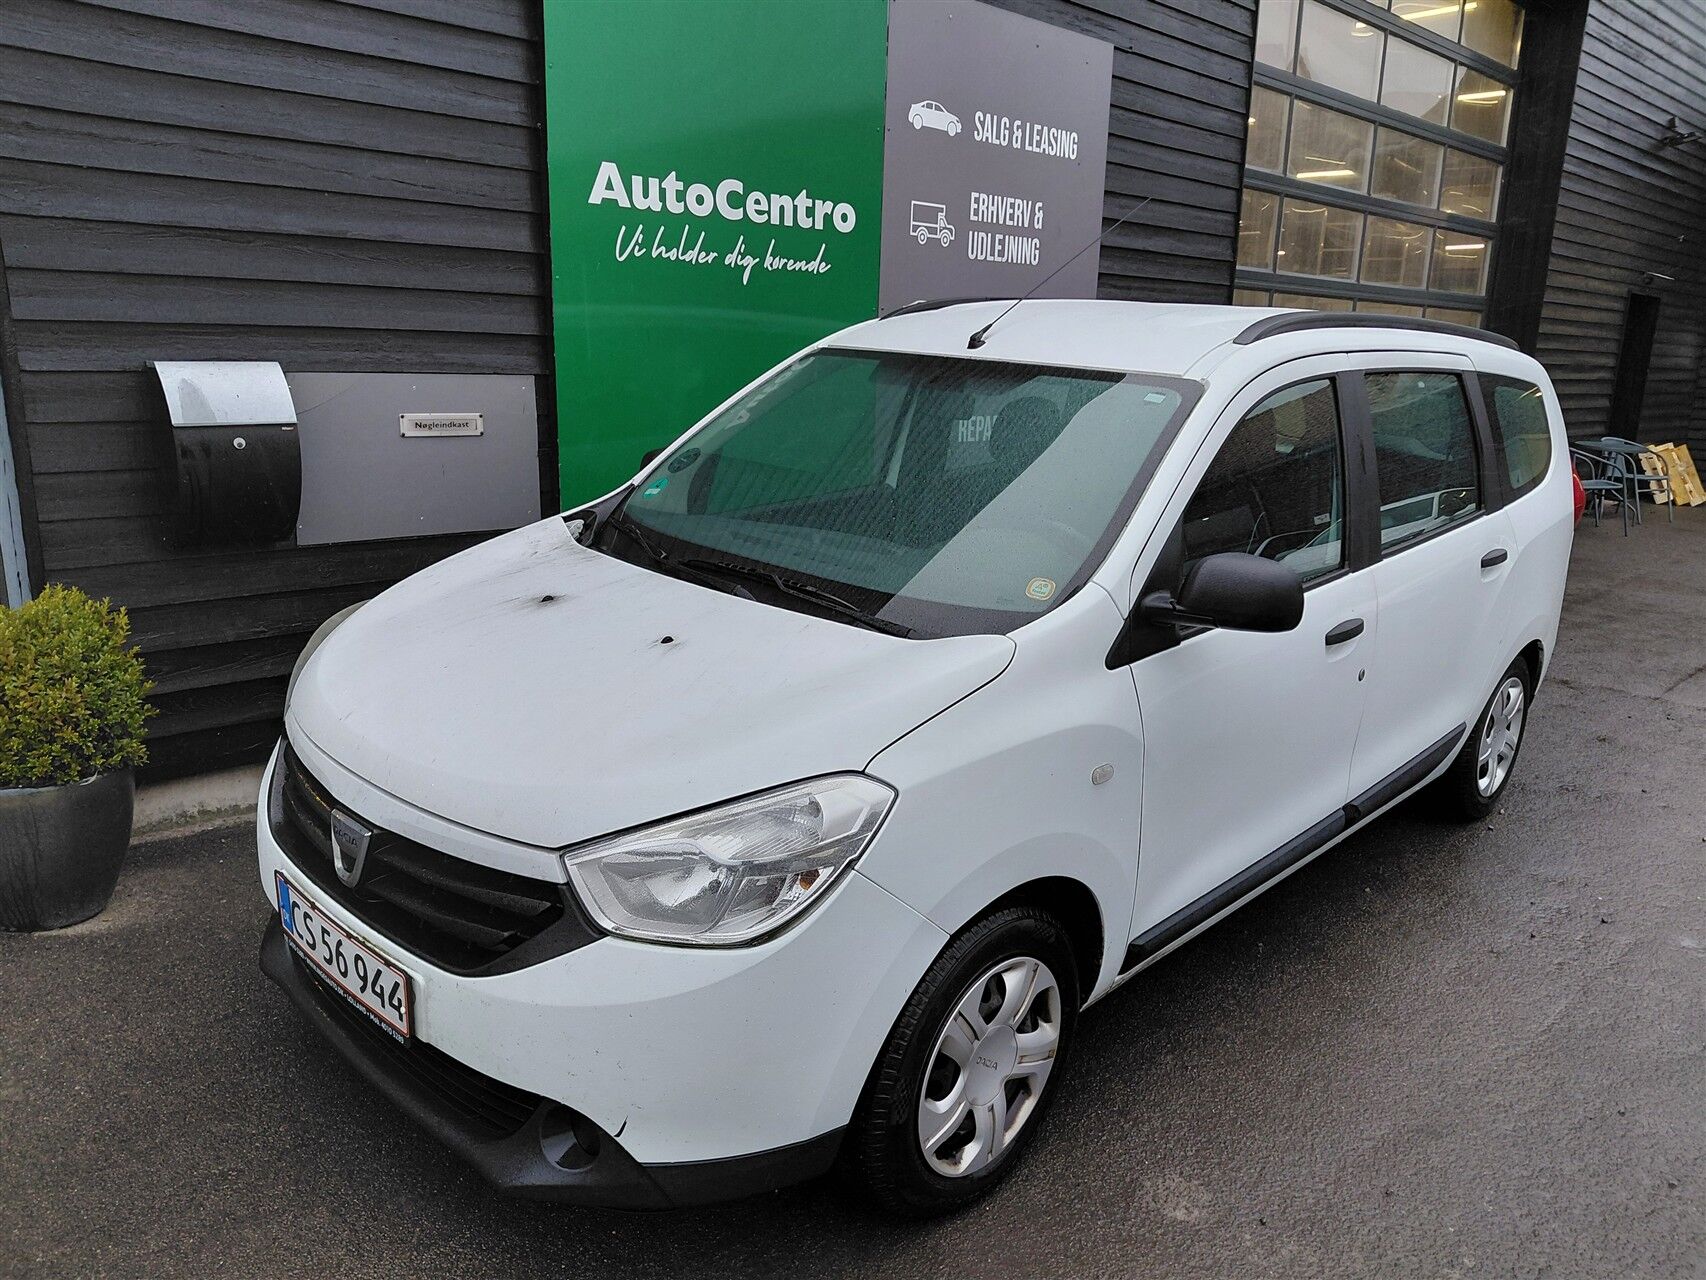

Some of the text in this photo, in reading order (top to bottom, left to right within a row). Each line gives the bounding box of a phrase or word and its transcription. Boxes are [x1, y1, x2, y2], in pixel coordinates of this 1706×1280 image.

[974, 110, 1078, 160] SALG & LEASING
[588, 161, 856, 233] AutoCentro
[970, 192, 1044, 230] ERHVERV &
[615, 224, 646, 262] Vi
[651, 224, 719, 265] holder
[724, 235, 760, 285] dig
[968, 231, 1040, 266] UDLEJNING
[415, 421, 470, 430] Nøgleindkast
[958, 415, 998, 442] REPA
[291, 900, 316, 951] CS
[321, 924, 349, 979] 56
[353, 953, 404, 1023] 944
